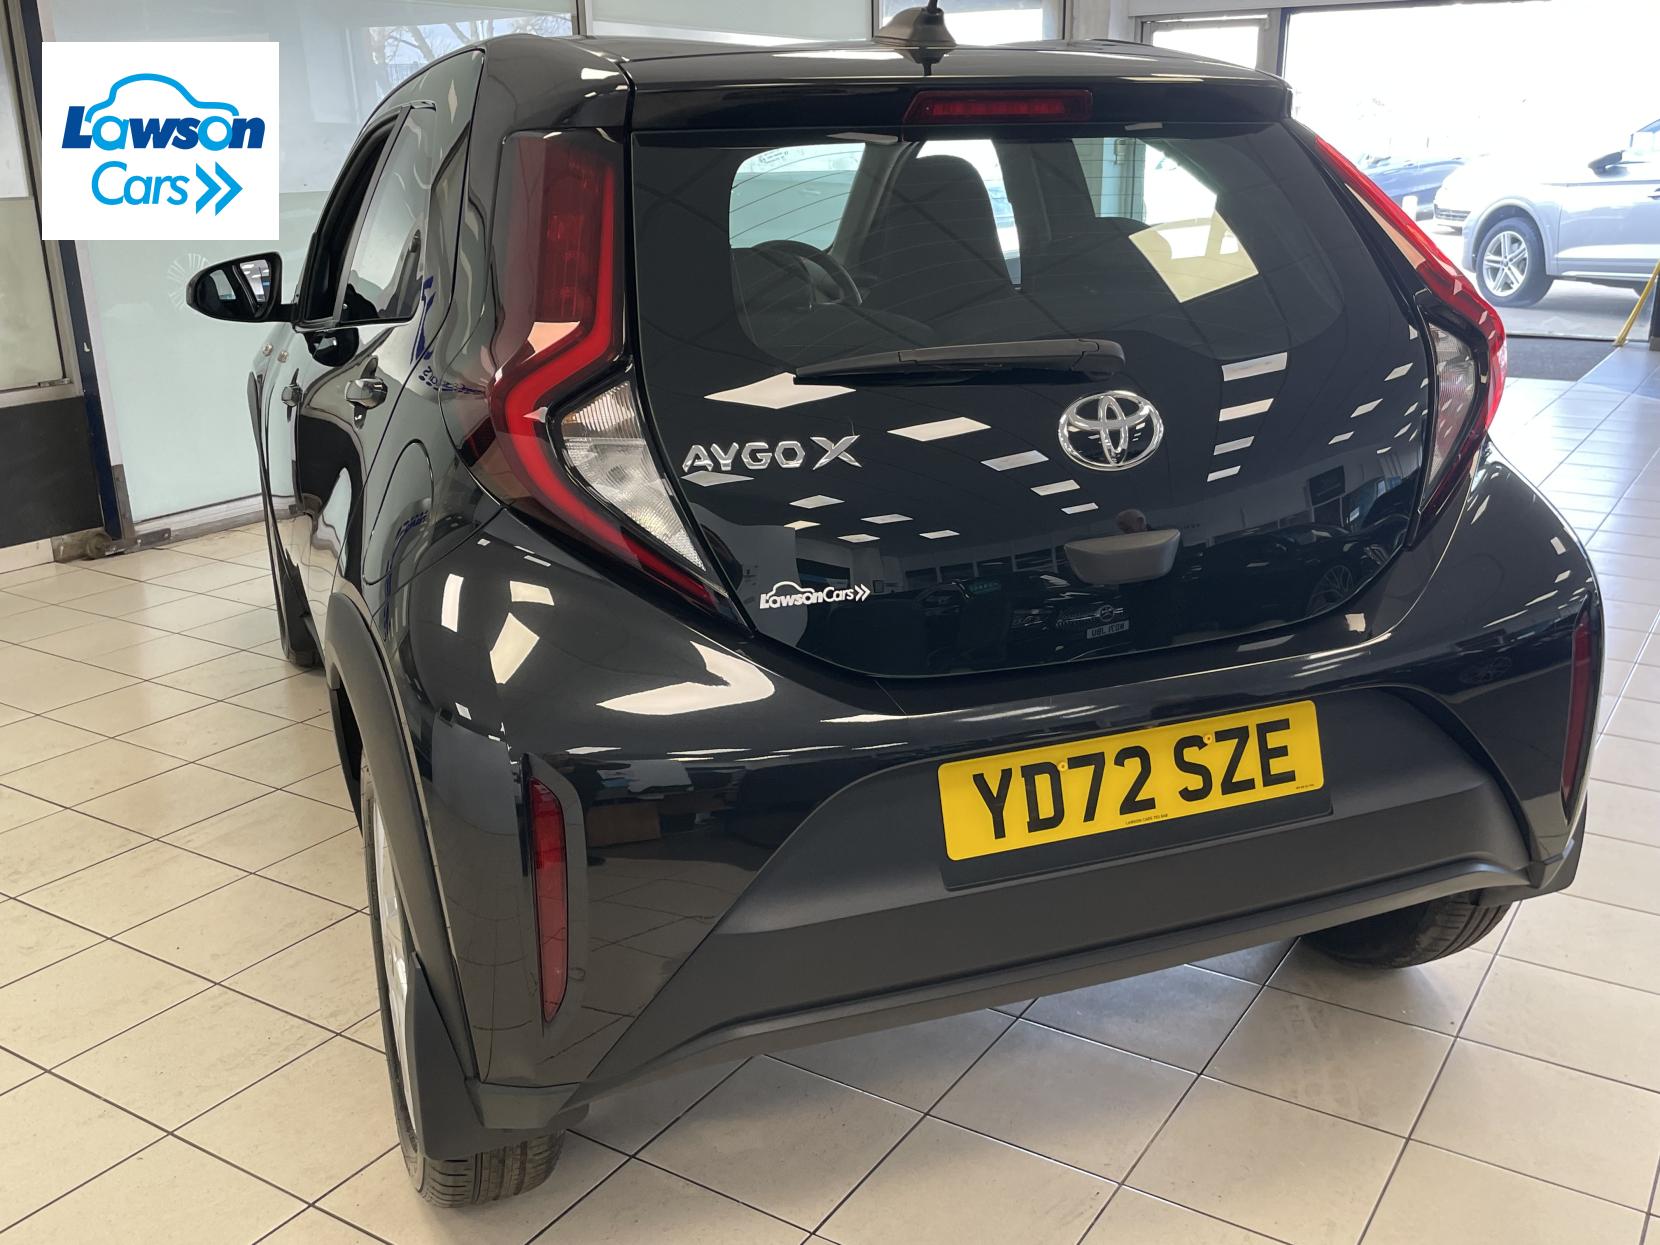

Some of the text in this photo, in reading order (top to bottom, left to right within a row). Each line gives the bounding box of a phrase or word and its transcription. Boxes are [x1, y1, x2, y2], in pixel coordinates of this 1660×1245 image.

[682, 434, 863, 473] AYGO X
[972, 718, 1297, 840] YD72 SZE
